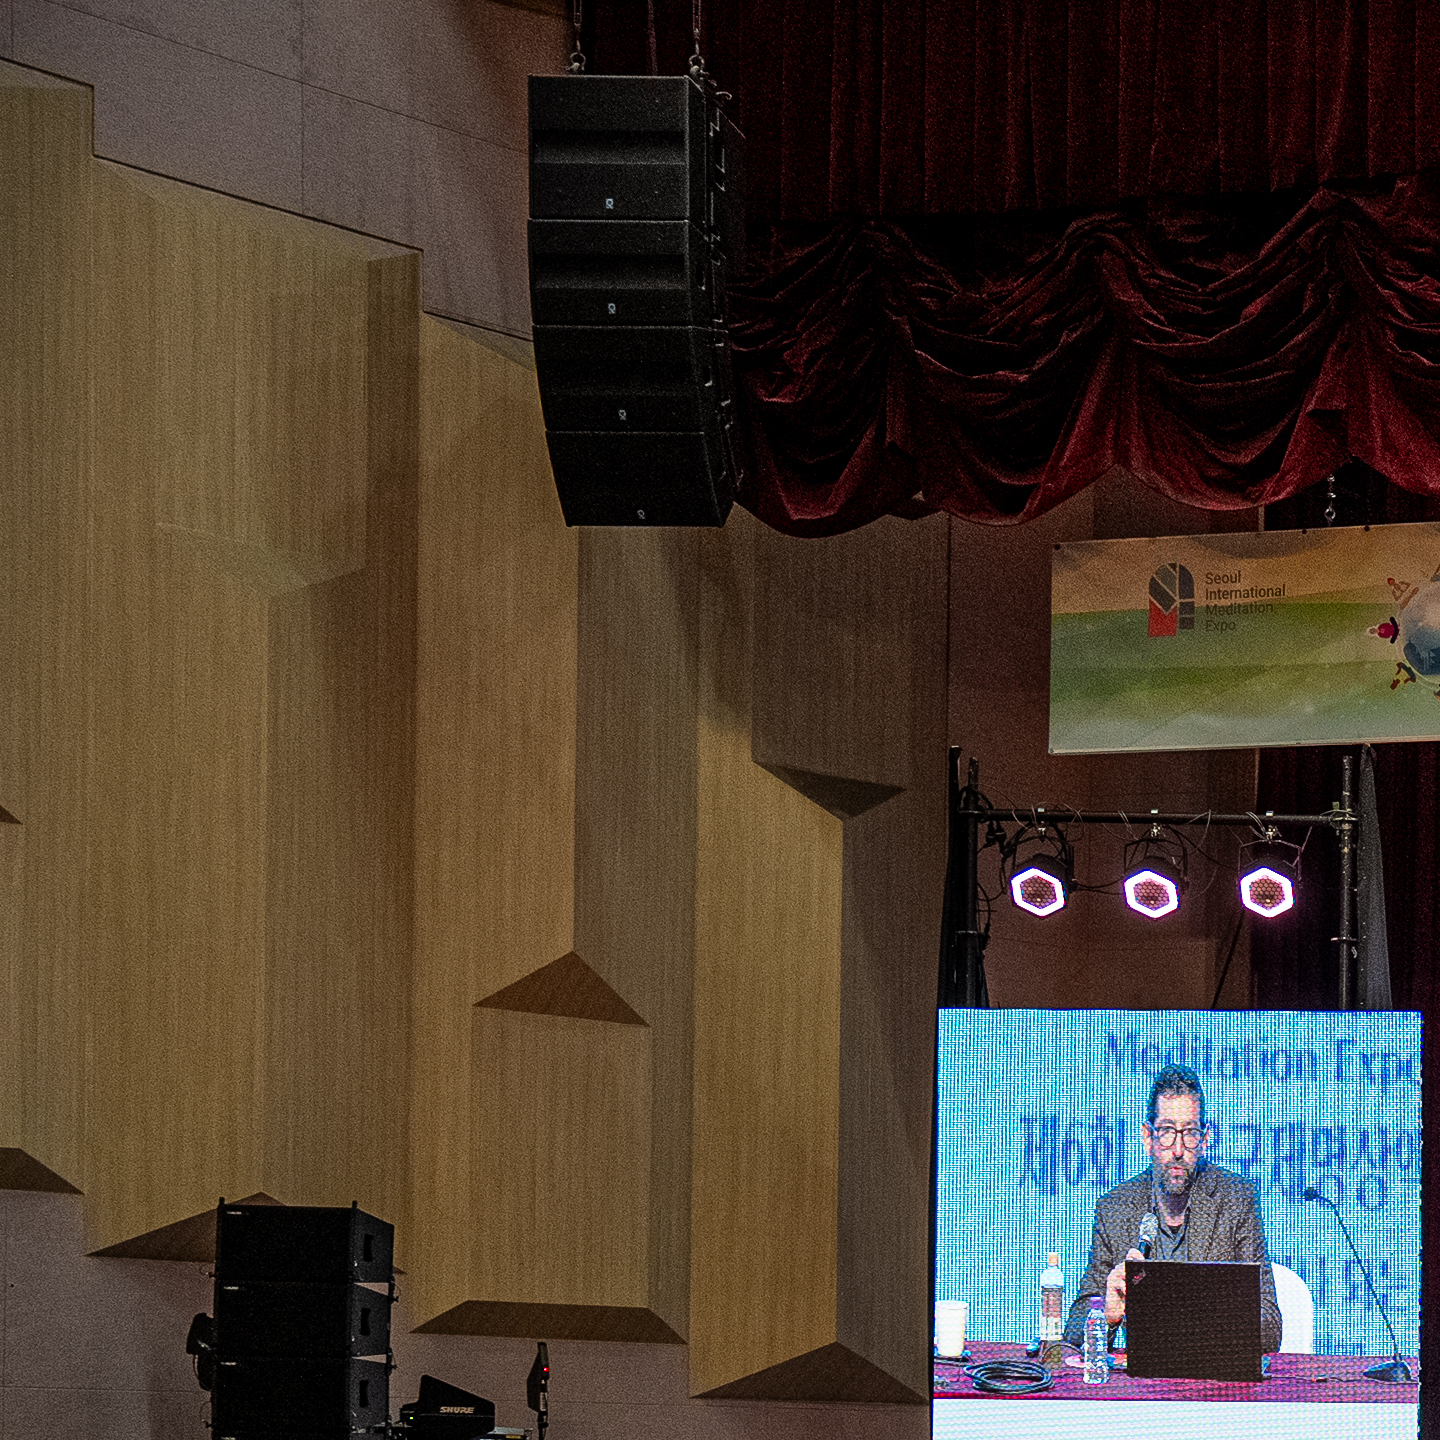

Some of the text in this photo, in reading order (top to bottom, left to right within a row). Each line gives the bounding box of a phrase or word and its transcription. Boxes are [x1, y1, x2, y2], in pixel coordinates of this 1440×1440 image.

[1205, 570, 1241, 585] Seoul
[1205, 584, 1286, 600] International
[1205, 603, 1274, 617] Meditation
[1205, 619, 1236, 634] Expo
[440, 1406, 474, 1414] SHURE
